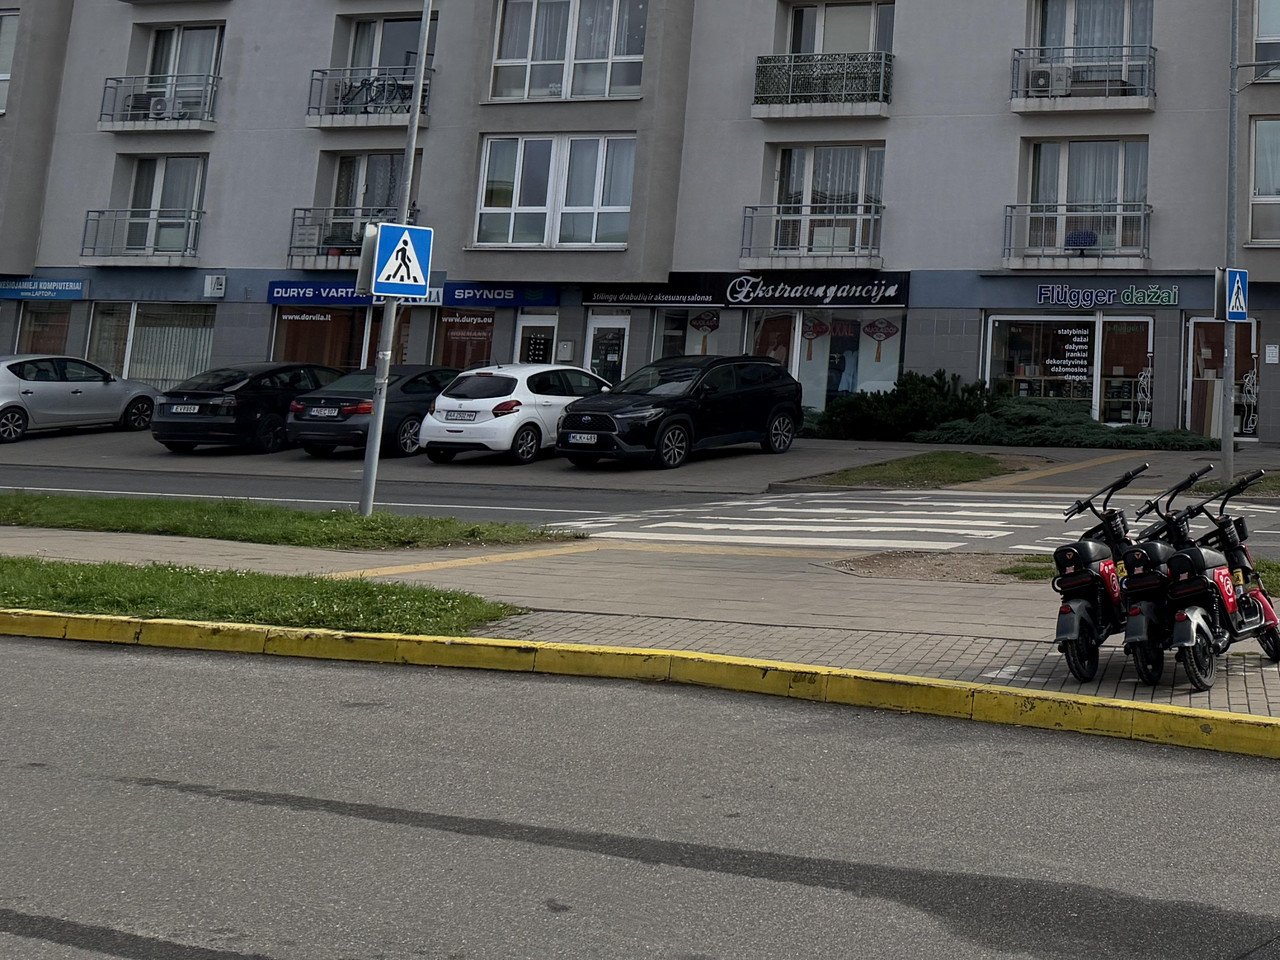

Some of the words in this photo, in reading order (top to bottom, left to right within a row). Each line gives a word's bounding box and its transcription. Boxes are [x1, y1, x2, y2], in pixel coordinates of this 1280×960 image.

[273, 288, 314, 298] DURYS
[320, 288, 366, 298] VART
[454, 289, 515, 299] SPYNOS
[726, 275, 899, 304] Ekstravagancija
[687, 293, 713, 302] salonas
[1037, 284, 1118, 309] Flügger
[1120, 284, 1179, 305] dažai
[441, 315, 493, 325] www.durys.eu
